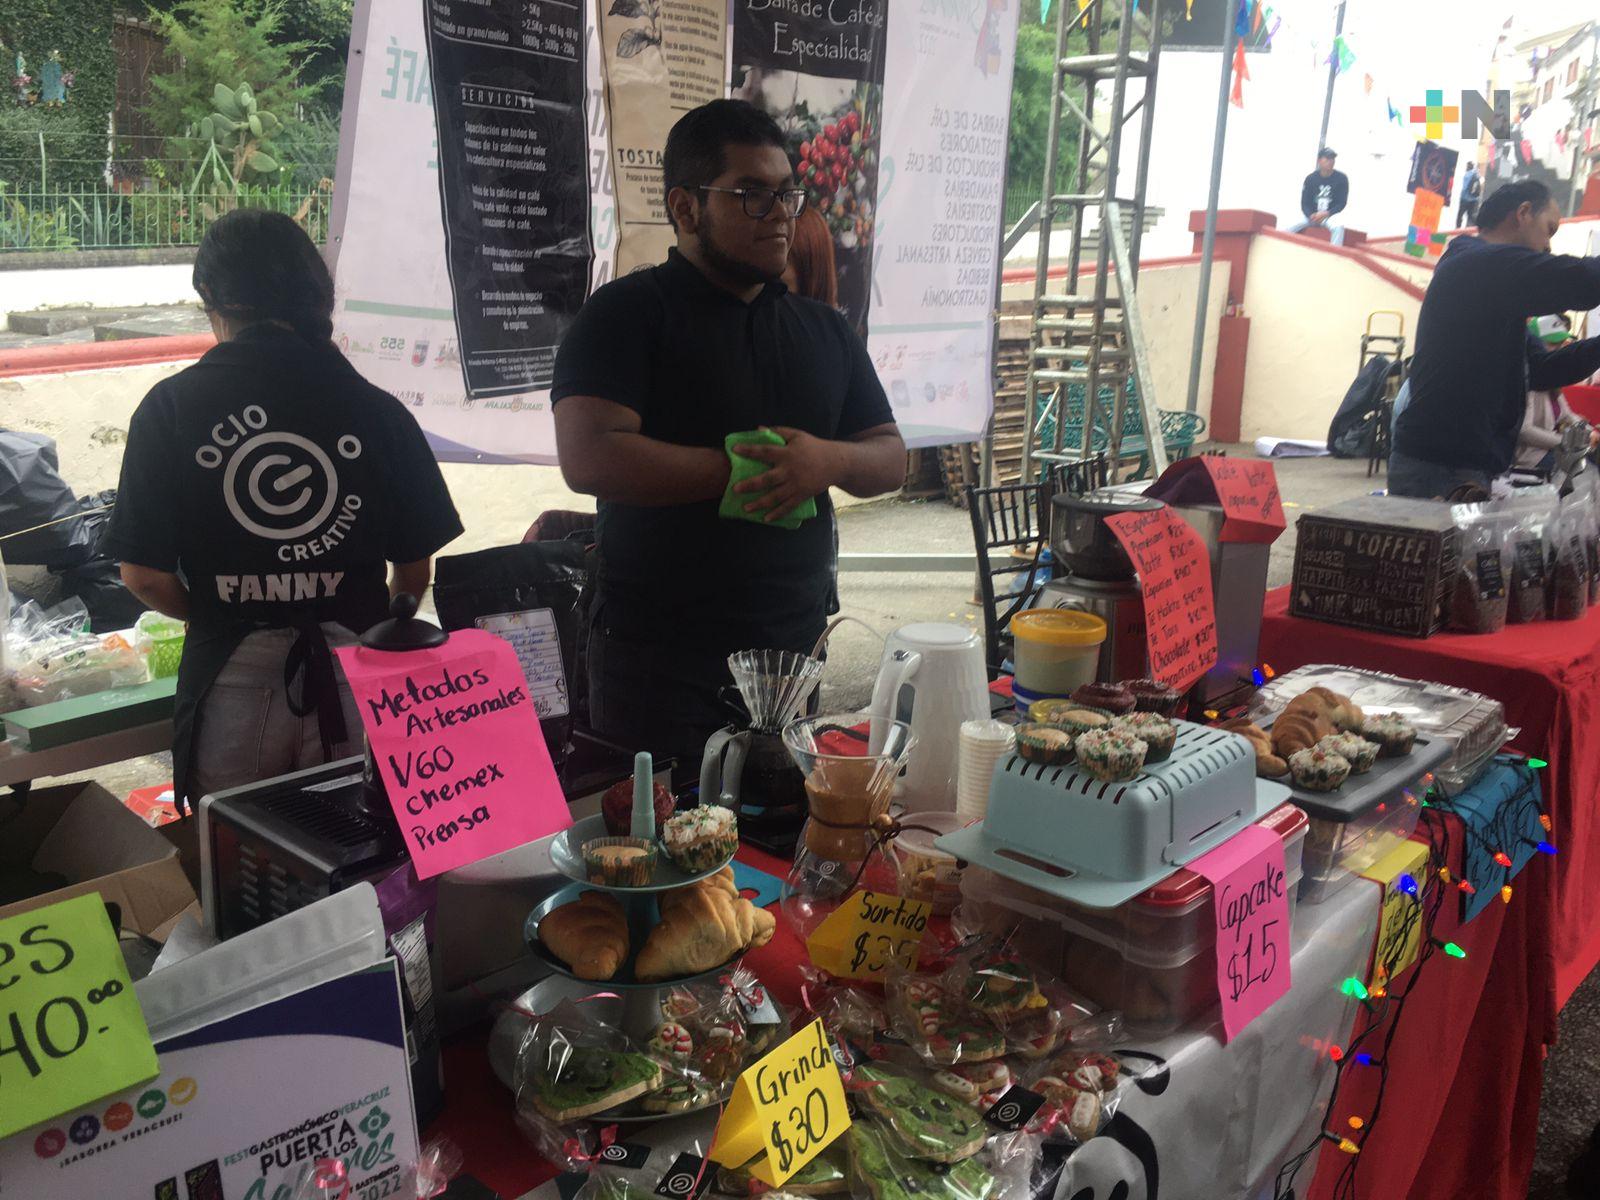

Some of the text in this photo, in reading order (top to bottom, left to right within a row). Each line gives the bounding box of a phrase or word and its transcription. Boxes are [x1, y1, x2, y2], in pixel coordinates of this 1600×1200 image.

[828, 0, 873, 25] Café
[195, 404, 268, 469] OCIO
[337, 434, 362, 460] O
[277, 494, 362, 562] CREATIVO
[1357, 532, 1427, 564] COFFEE
[215, 571, 345, 603] FANNY
[367, 668, 489, 727] Metodos
[406, 686, 527, 738] Artesanales
[388, 745, 454, 789] V60
[411, 804, 491, 851] Prensa
[860, 891, 927, 932] Surtido
[1228, 919, 1280, 1003] $15
[756, 1020, 832, 1106] Grinch
[261, 1119, 356, 1177] PUERTA
[333, 1137, 359, 1158] LOS
[771, 1087, 828, 1174] $30
